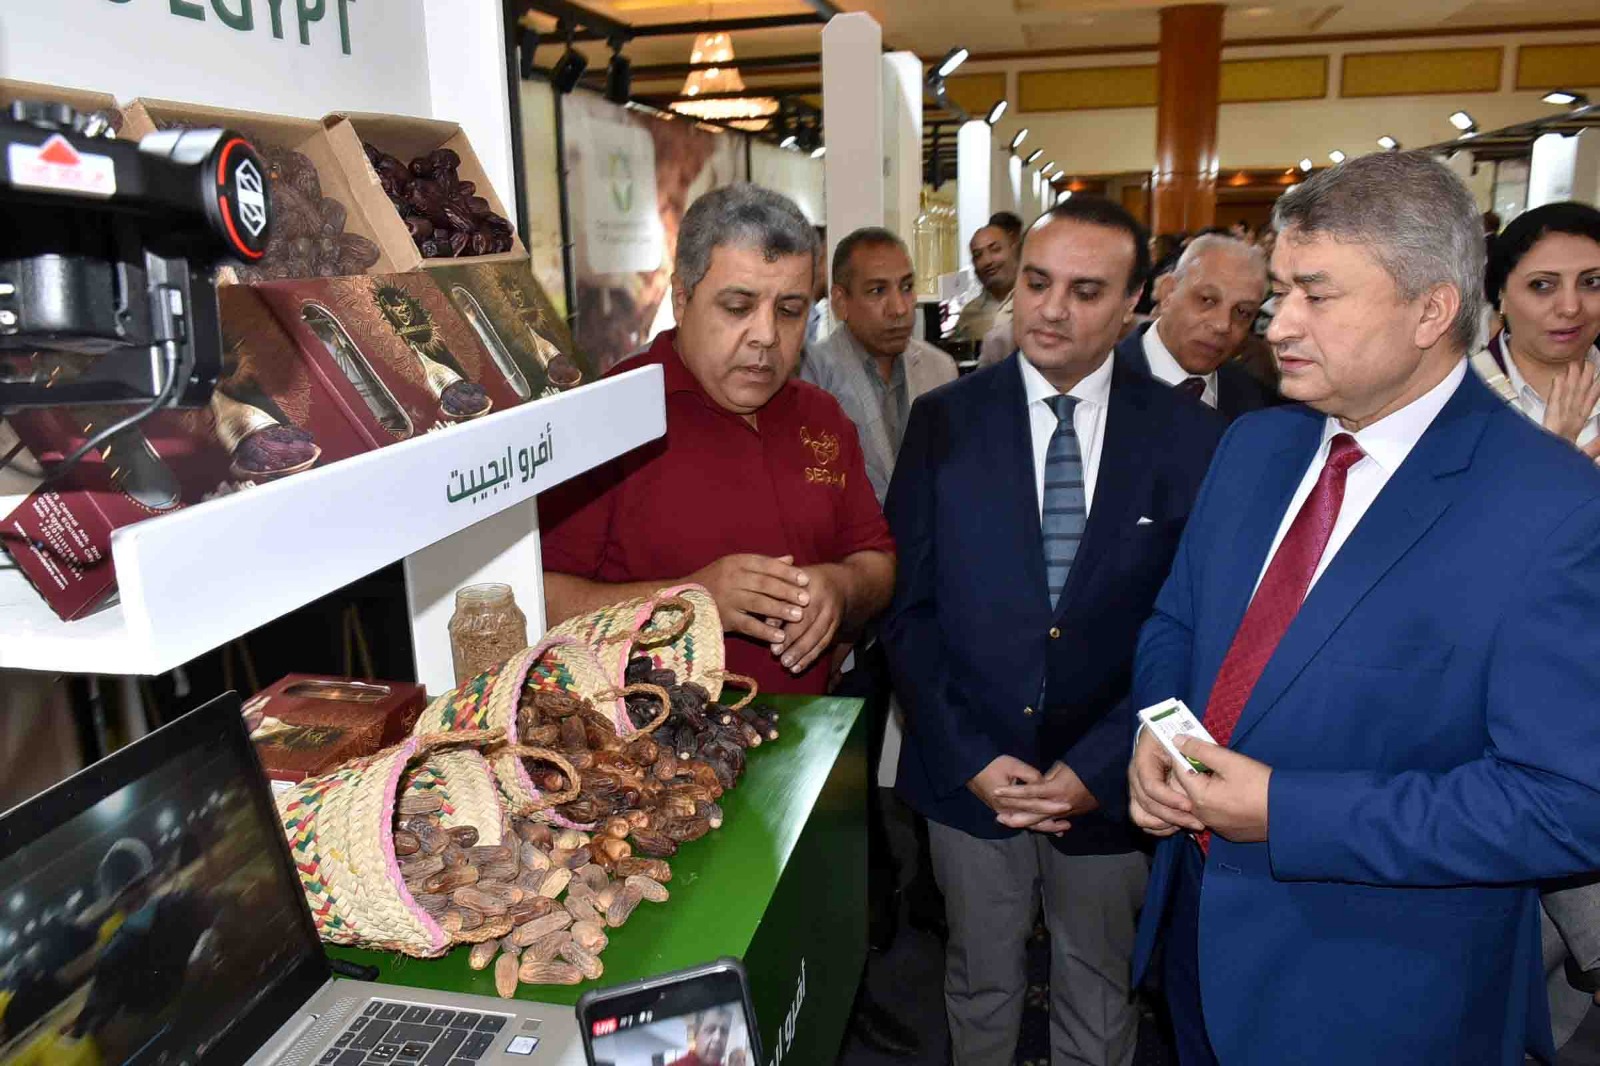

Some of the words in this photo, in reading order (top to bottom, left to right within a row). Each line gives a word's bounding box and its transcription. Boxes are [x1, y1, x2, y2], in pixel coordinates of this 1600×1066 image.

[446, 446, 513, 504] ايجيبت
[518, 422, 553, 483] أفرو
[59, 502, 79, 527] Central
